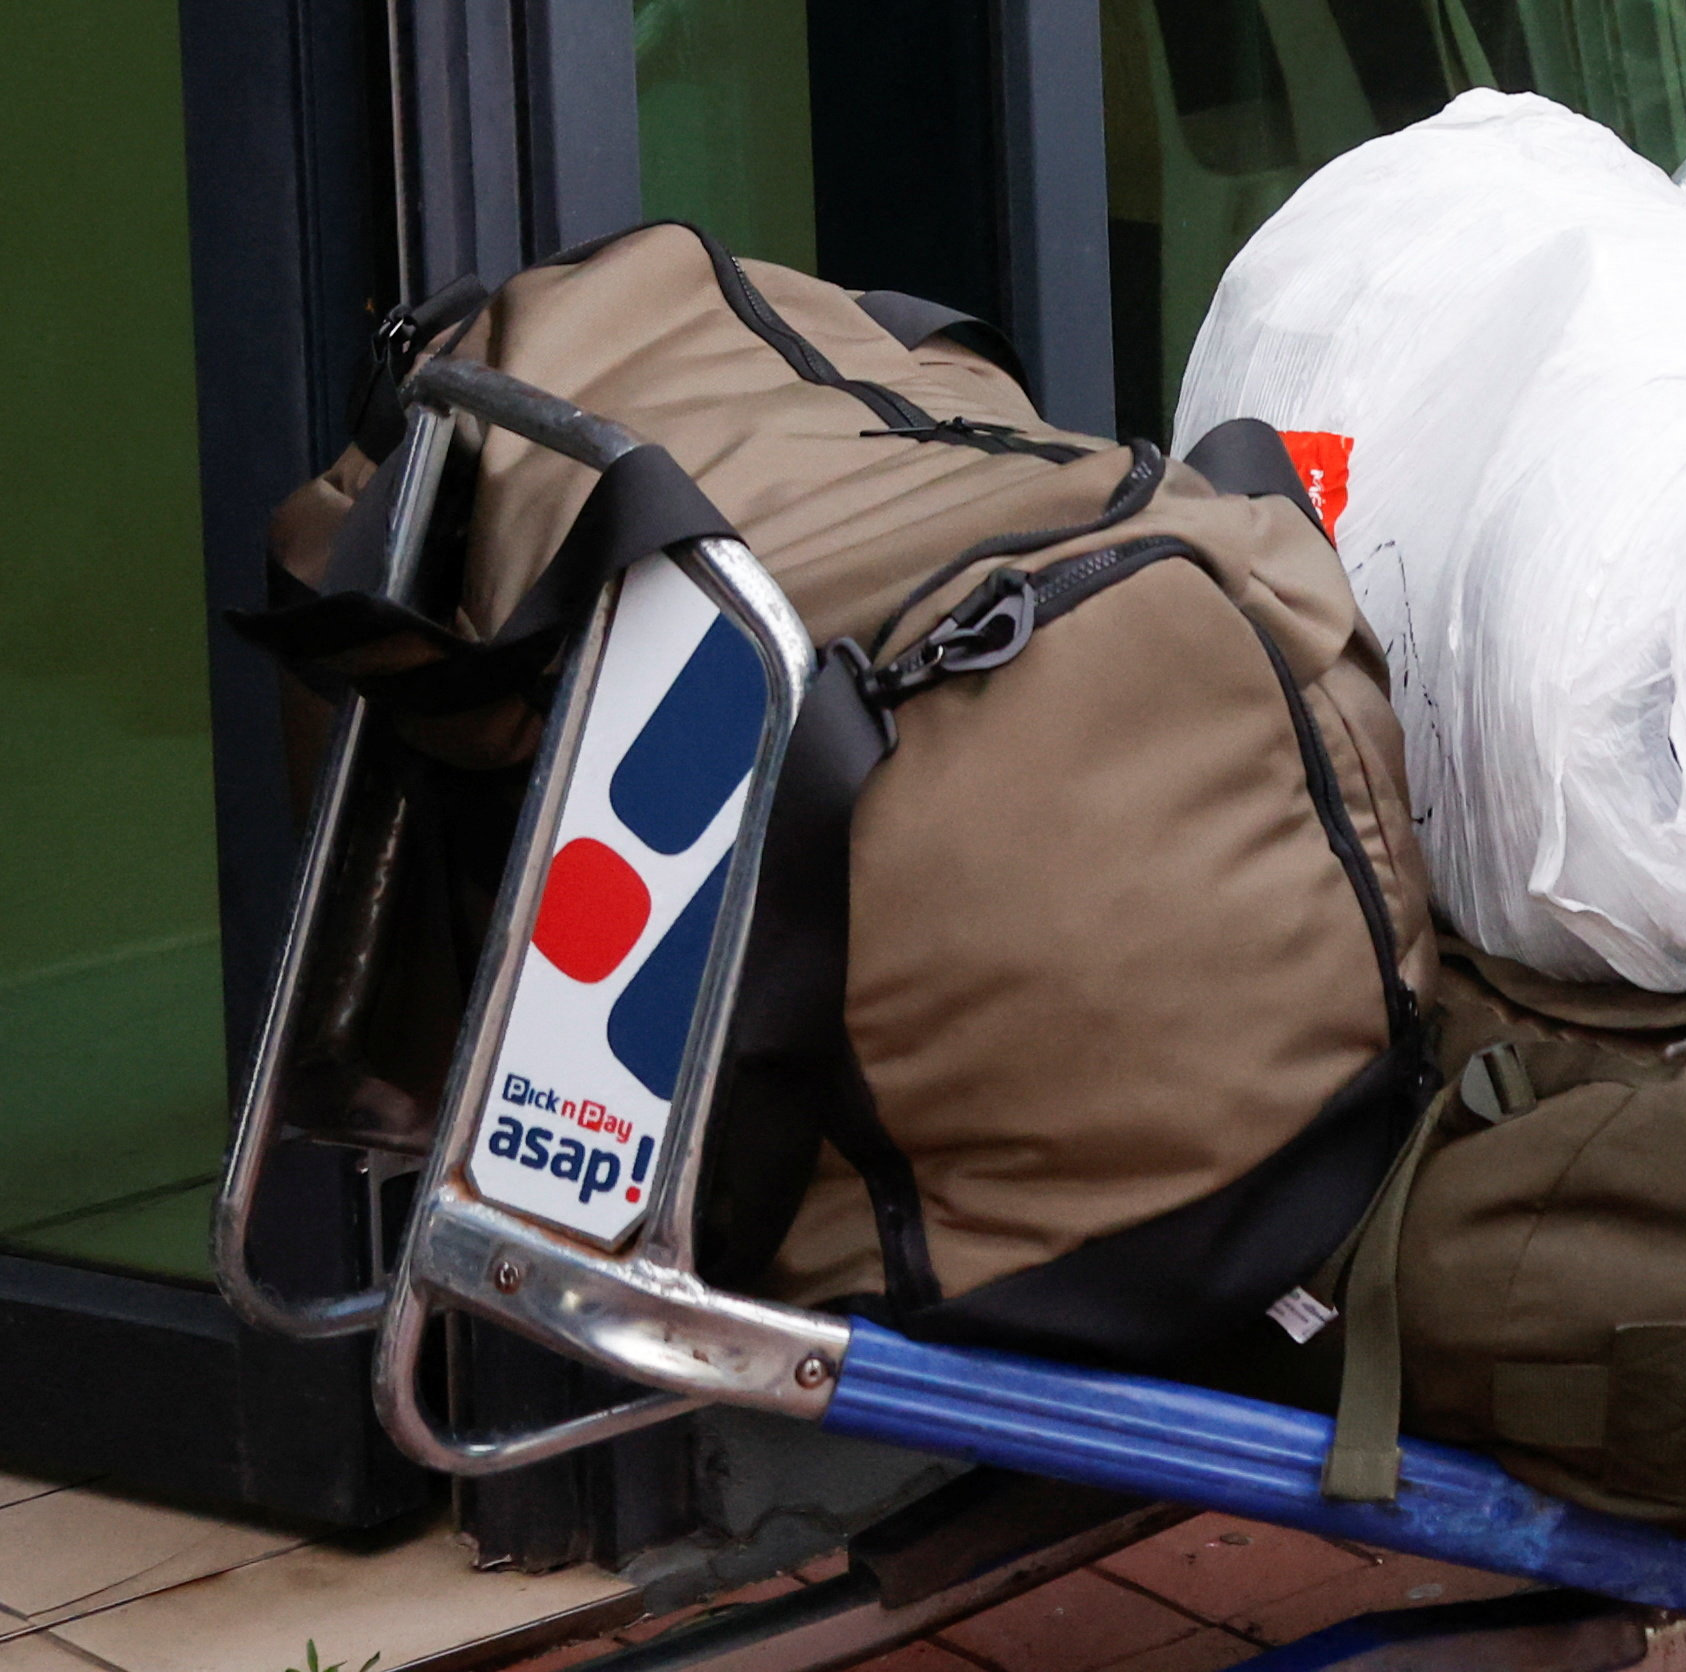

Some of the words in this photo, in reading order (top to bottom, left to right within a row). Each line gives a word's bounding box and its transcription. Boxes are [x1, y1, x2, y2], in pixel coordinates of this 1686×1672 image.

[502, 1073, 561, 1115] Pick
[561, 1099, 575, 1119] n
[577, 1099, 633, 1144] Pay
[488, 1116, 655, 1204] asap!
